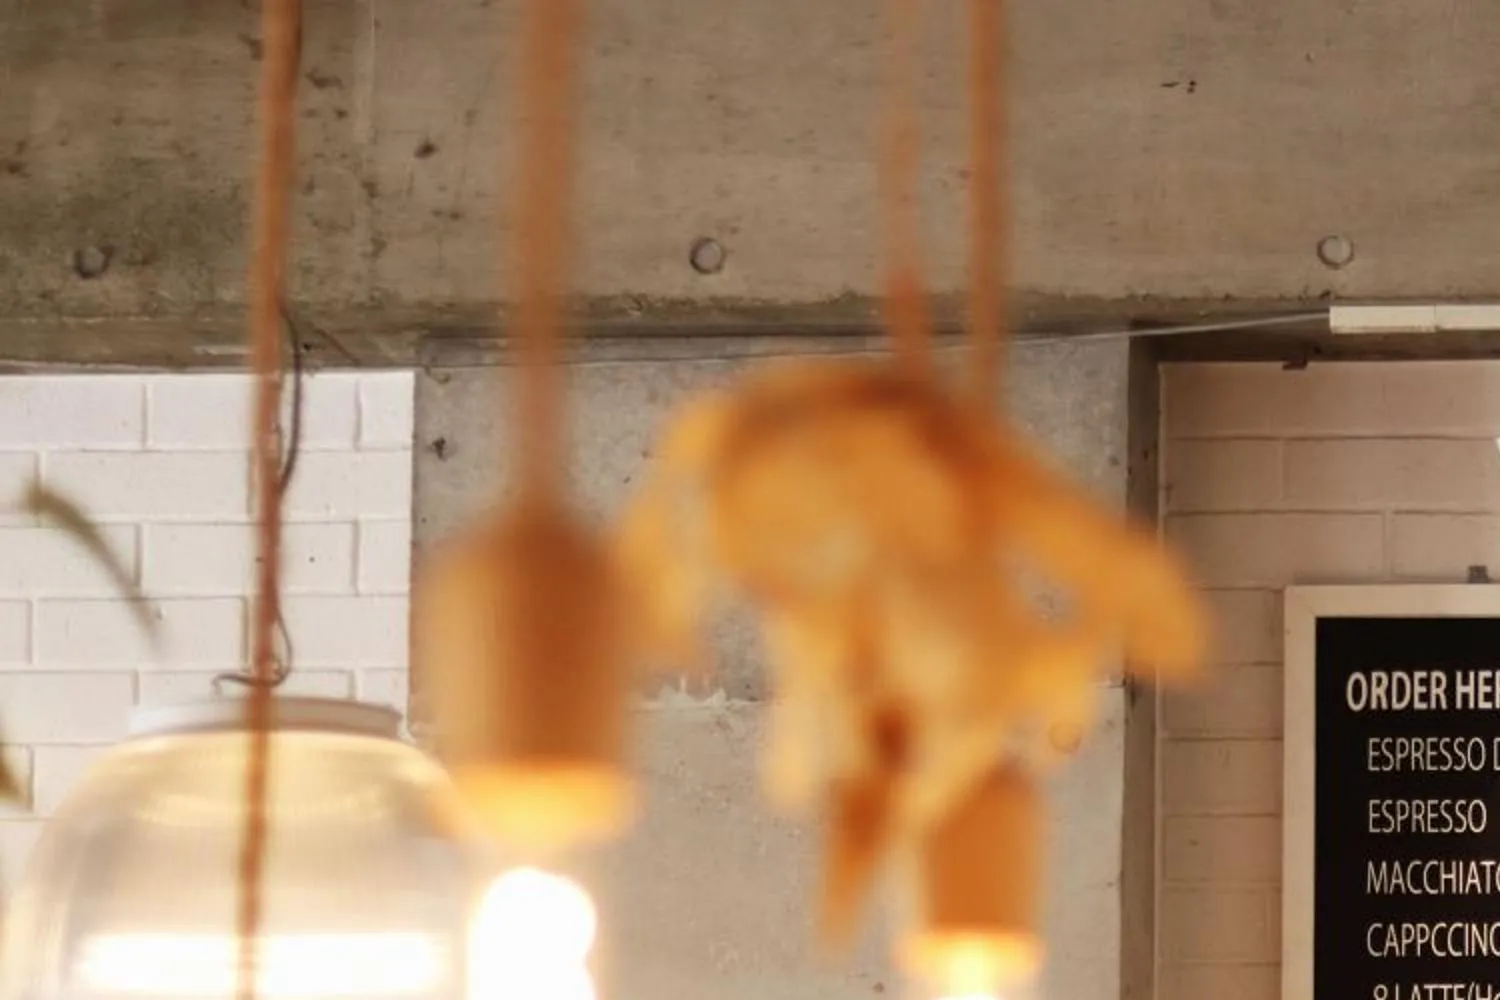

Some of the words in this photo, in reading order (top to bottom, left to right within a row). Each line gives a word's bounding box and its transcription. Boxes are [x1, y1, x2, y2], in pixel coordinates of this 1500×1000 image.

[1347, 671, 1447, 711] ORDER
[1367, 738, 1485, 773] ESPRESSO
[1367, 799, 1487, 834] ESPRESSO
